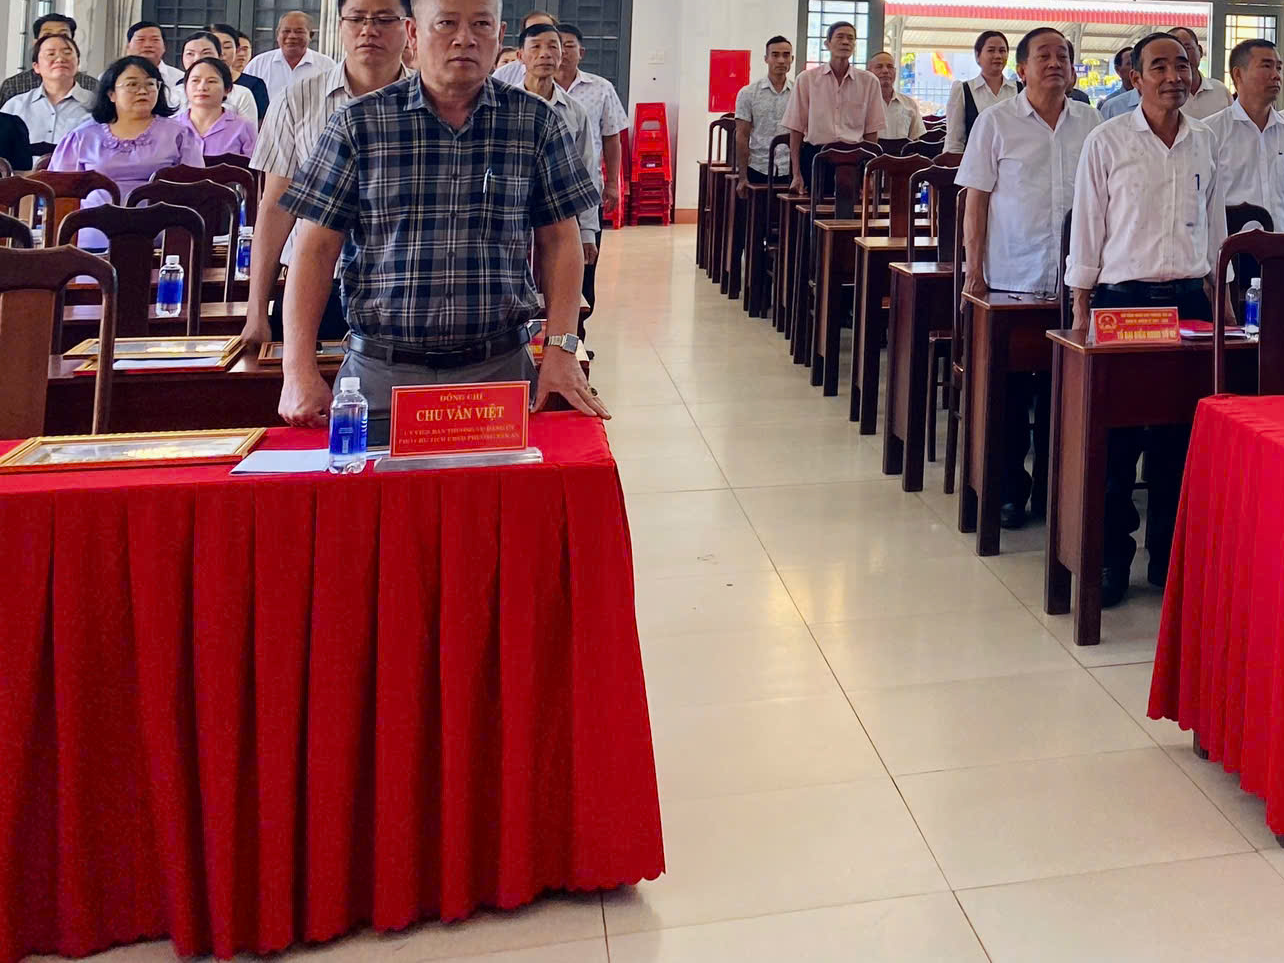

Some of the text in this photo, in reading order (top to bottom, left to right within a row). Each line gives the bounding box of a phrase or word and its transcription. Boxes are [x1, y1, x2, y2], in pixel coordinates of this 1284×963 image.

[416, 403, 505, 422] CHU VĂN VIỆT
